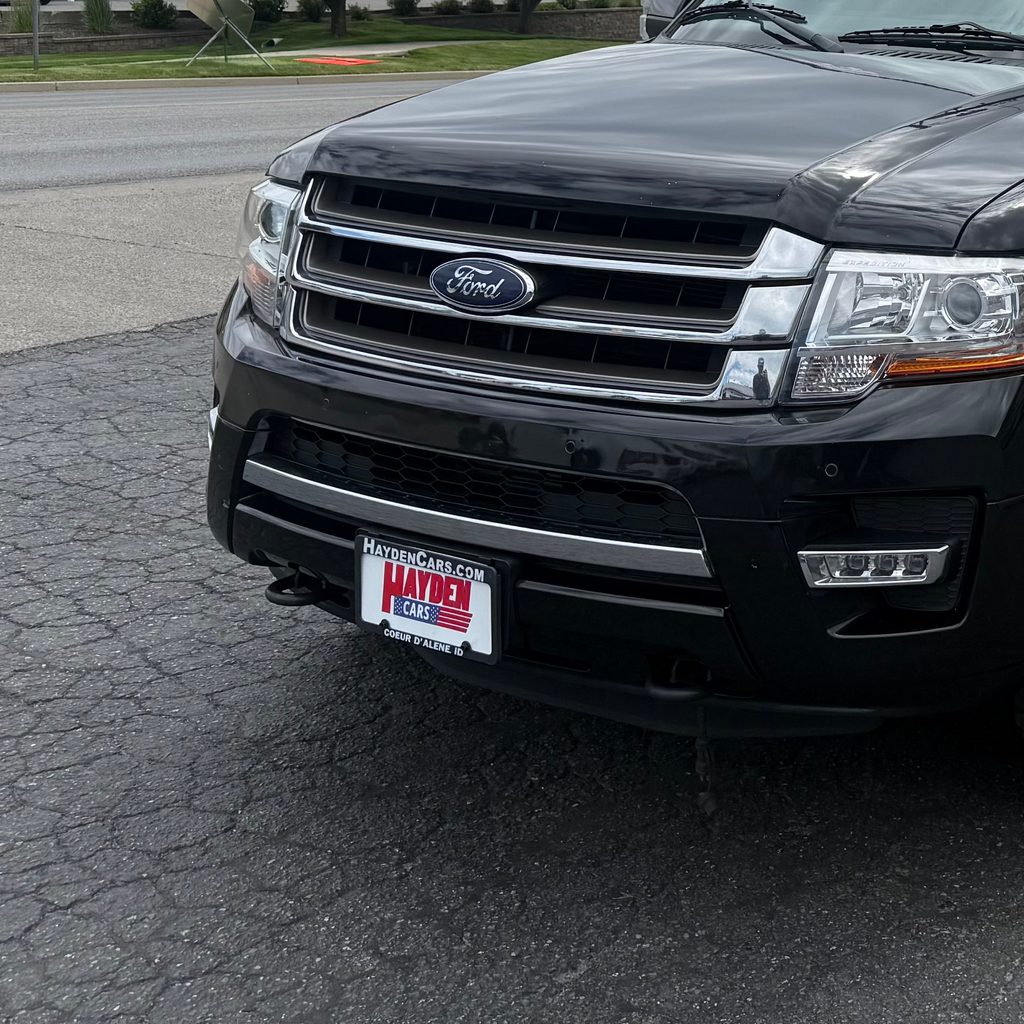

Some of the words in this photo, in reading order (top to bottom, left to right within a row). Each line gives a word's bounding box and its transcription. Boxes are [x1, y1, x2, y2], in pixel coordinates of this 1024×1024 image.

[446, 265, 505, 299] Ford
[381, 561, 472, 614] HAYDEN
[402, 600, 430, 621] CARS
[384, 628, 411, 643] COEUR
[454, 647, 464, 657] ID
